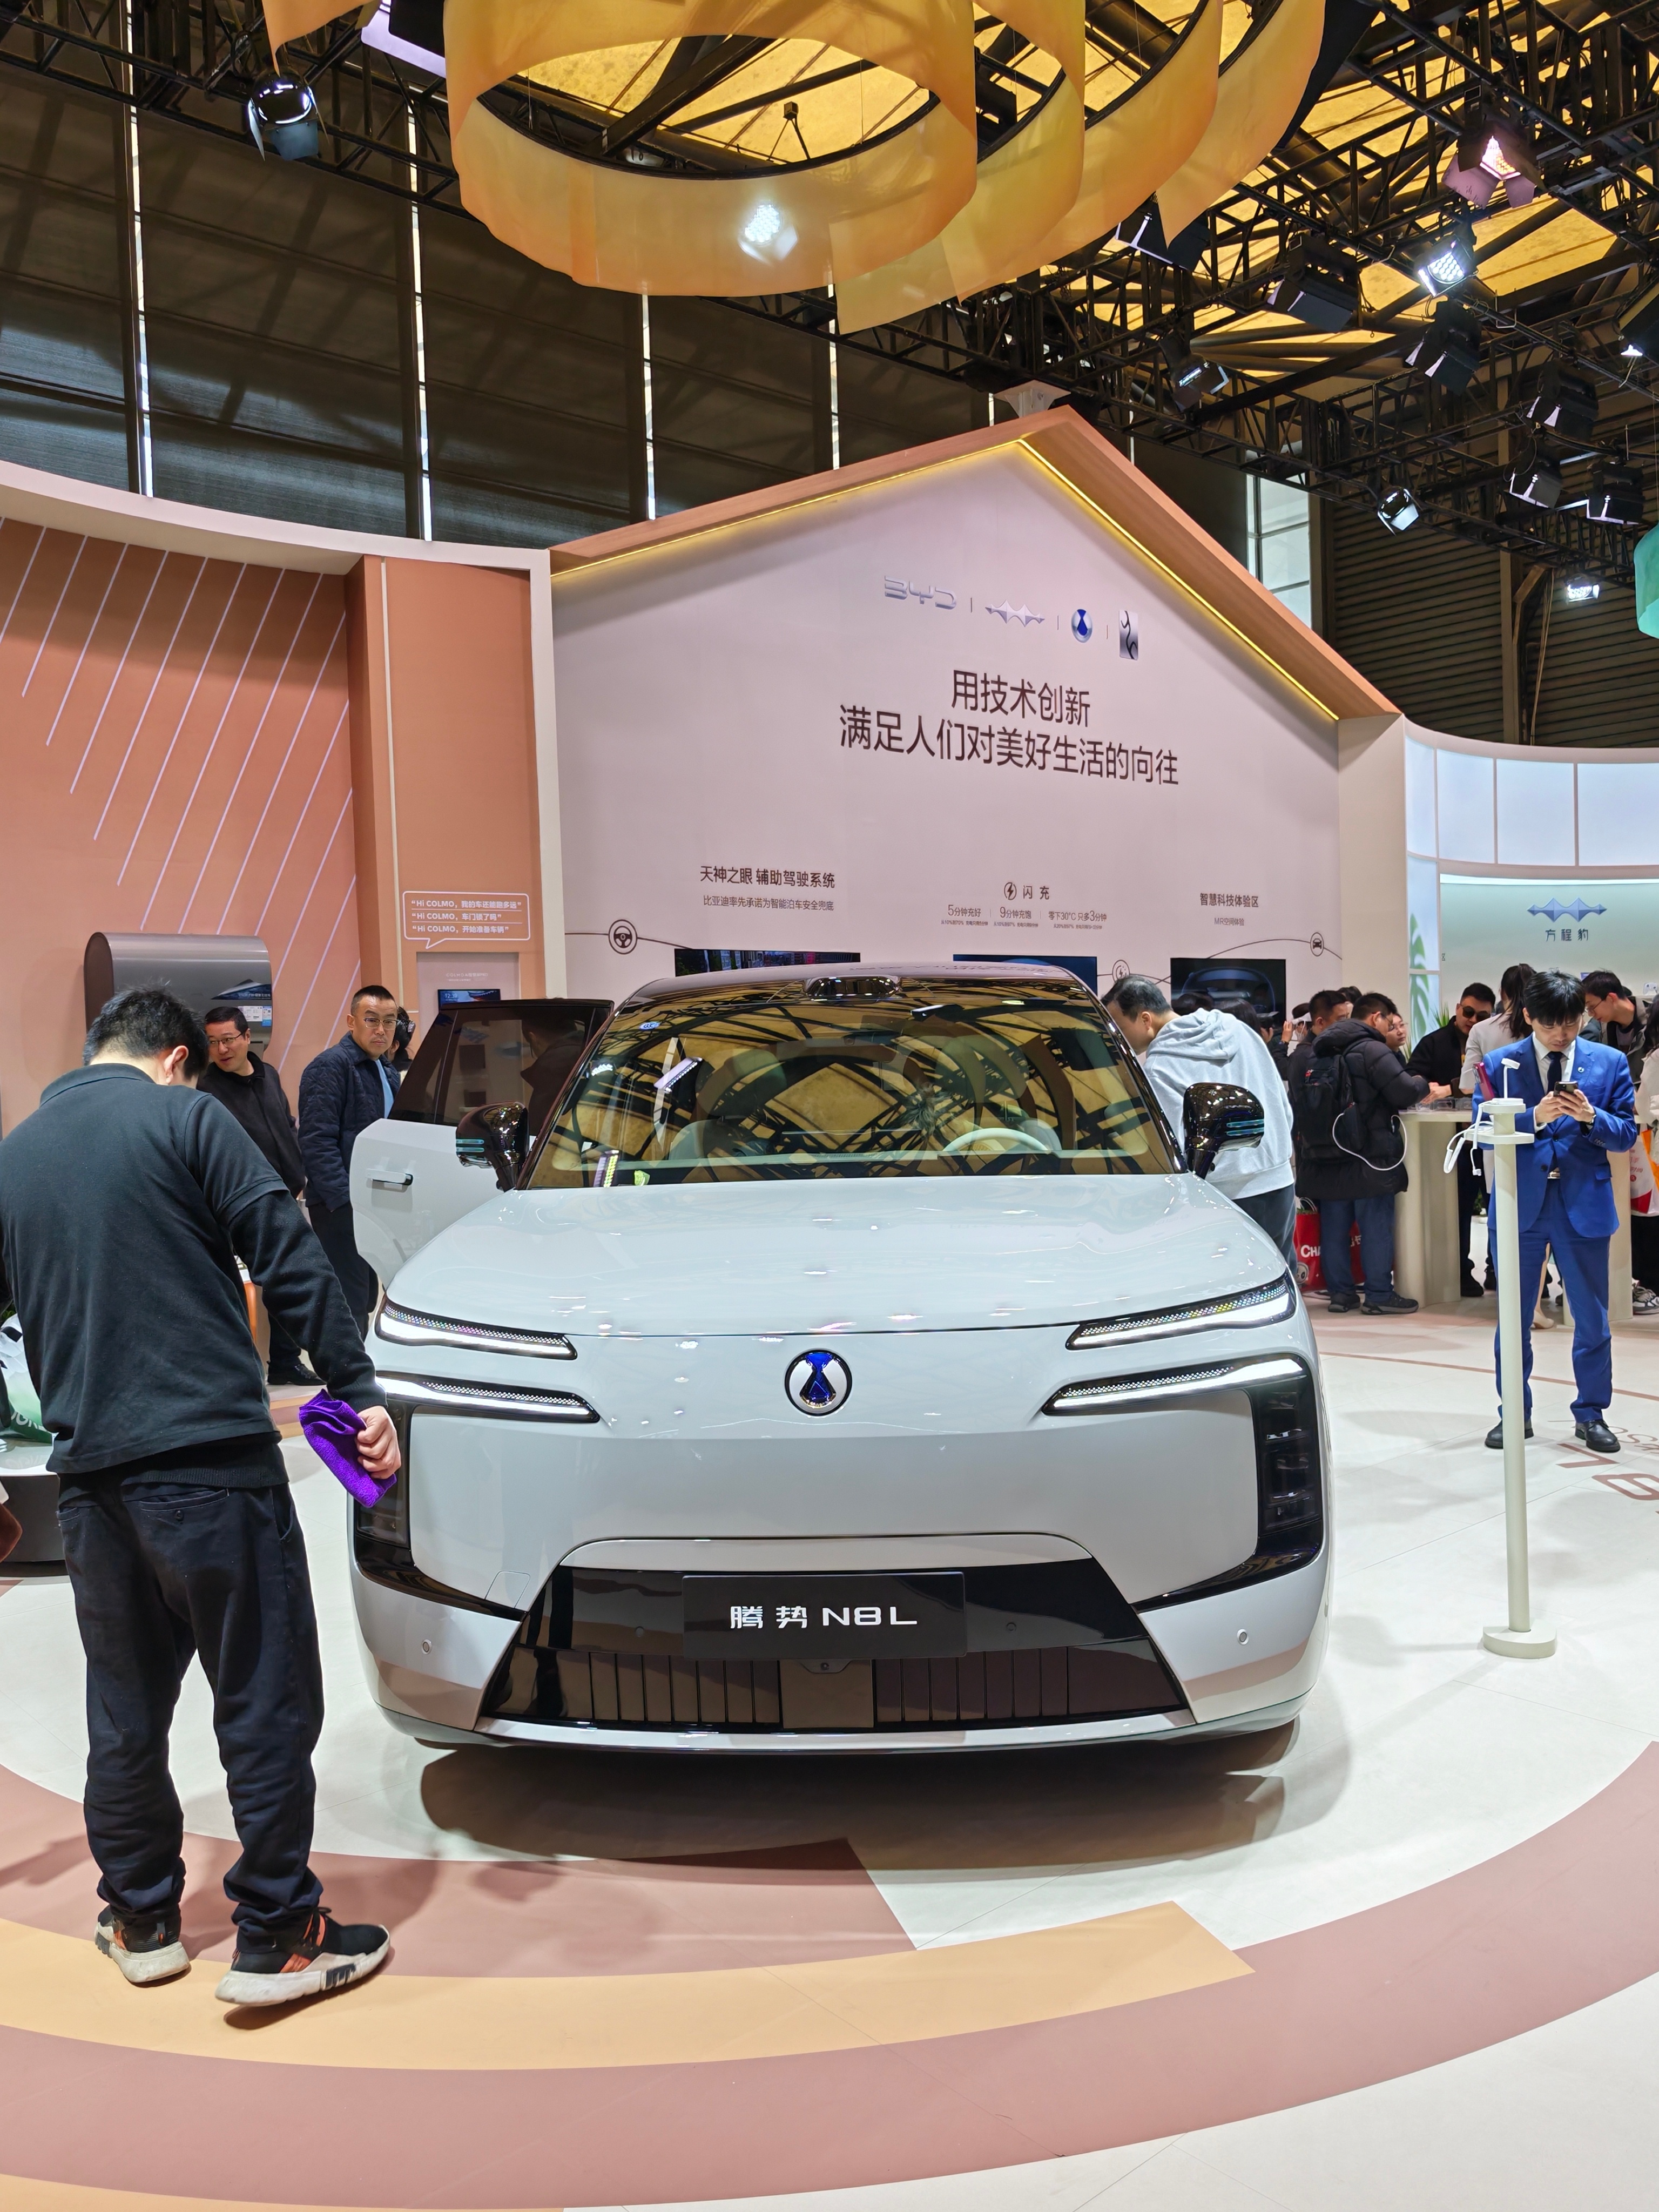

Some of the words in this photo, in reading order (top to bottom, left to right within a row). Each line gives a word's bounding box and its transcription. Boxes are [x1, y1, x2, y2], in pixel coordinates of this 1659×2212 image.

[884, 575, 957, 610] BYD
[951, 669, 1091, 727] 用技术创新
[839, 704, 1179, 786] 满足人们对美好生活的向往
[700, 865, 753, 885] 天神之眼
[756, 868, 835, 889] 辅助驾驶系统
[1022, 885, 1050, 900] 闪充
[1199, 892, 1259, 908] 智慧科技体验区
[703, 894, 835, 912] 比亚迪率先承诺为智能泊车安全兜底
[947, 904, 982, 918] 5分钟充好
[999, 906, 1032, 920] 9分钟充饱
[1077, 910, 1107, 922] 只多3分钟
[1545, 928, 1589, 942] 方程豹
[730, 1605, 808, 1629] 腾势
[822, 1606, 918, 1627] N8L
